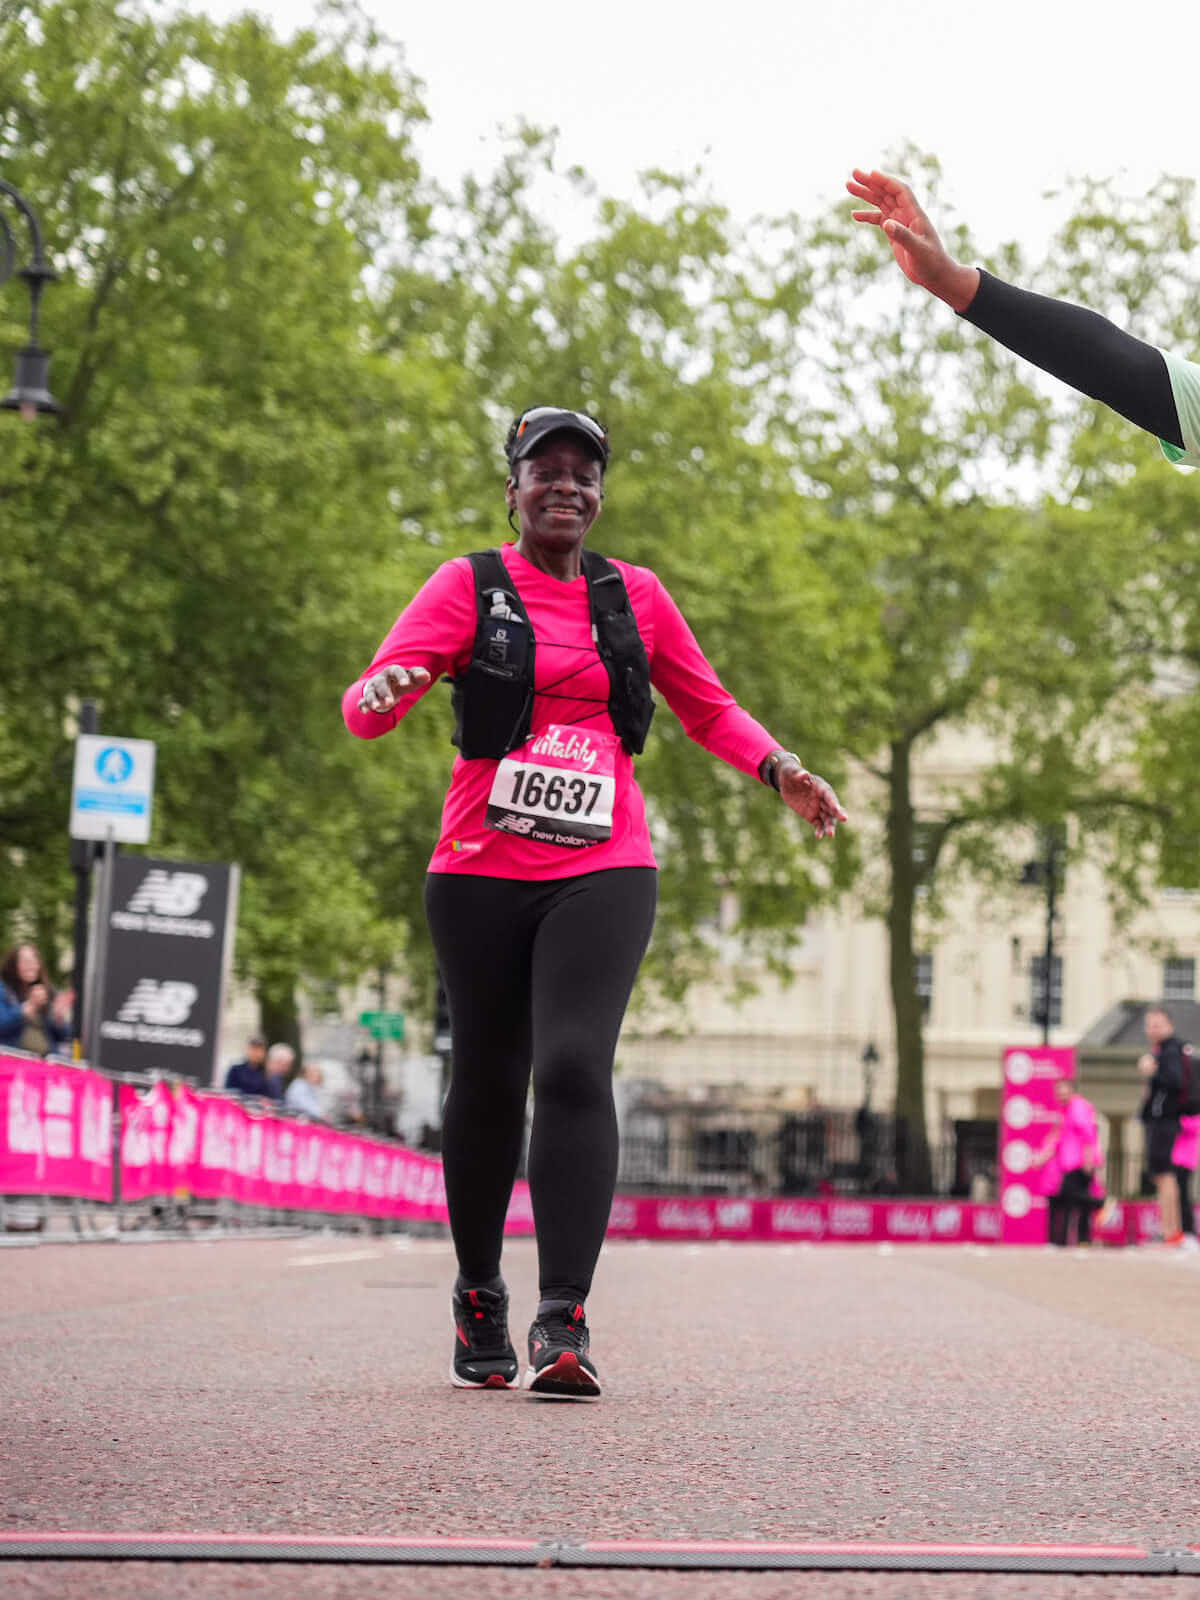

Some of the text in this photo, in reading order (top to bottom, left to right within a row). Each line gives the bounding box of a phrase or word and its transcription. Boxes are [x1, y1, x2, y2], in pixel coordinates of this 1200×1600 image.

[510, 769, 602, 817] 16637
[532, 830, 555, 842] new
[555, 833, 598, 847] balan
